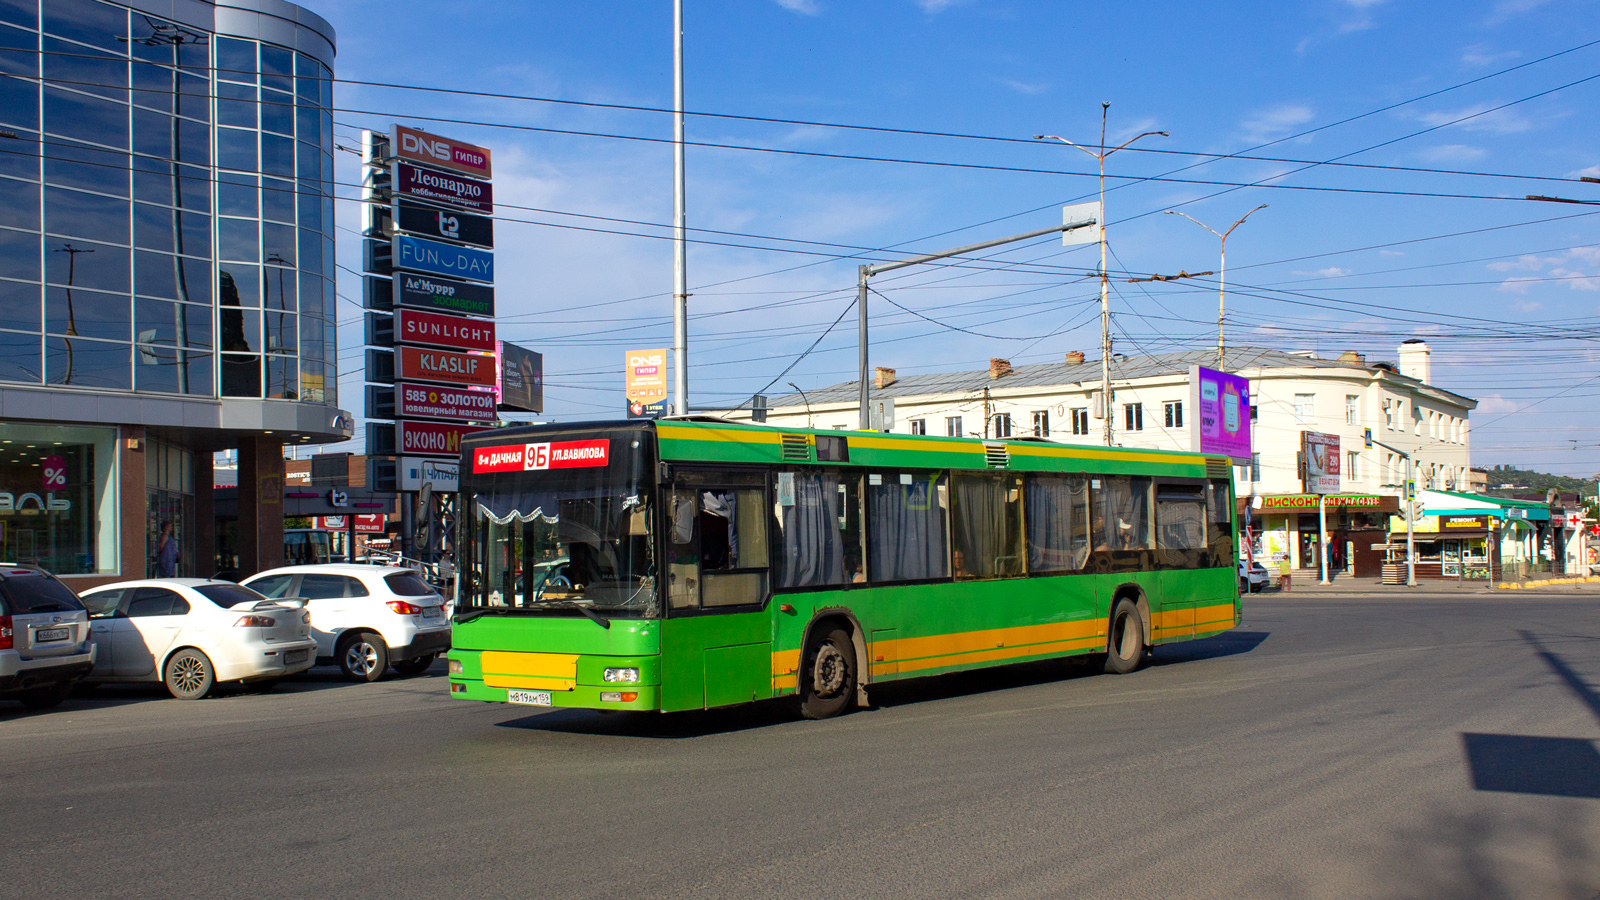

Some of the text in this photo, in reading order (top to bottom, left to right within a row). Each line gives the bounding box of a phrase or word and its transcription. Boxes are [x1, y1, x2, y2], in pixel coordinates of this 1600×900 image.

[402, 133, 483, 165] DNS ГИПЕР
[411, 168, 482, 197] Леонардо
[411, 187, 480, 207] хобби-гипермаркет
[438, 211, 459, 239] t2
[402, 244, 490, 275] FUN DAY
[407, 320, 491, 341] SUNLIGHT
[420, 353, 478, 375] KLASLIF
[630, 355, 662, 366] DNS
[405, 389, 493, 408] 585 ЗОЛОТОЙ
[405, 404, 494, 418] ювелирный магазин
[405, 430, 465, 452] ЭКОНОМ
[478, 454, 489, 465] 8-я
[490, 451, 522, 466] ДАЧНАЯ
[527, 446, 547, 468] 9Б
[332, 489, 348, 507] t2
[1265, 496, 1381, 508] ДИСКОНТ ОДЕЖДА ОБУВЬ
[510, 692, 549, 703] М819АМ 159
